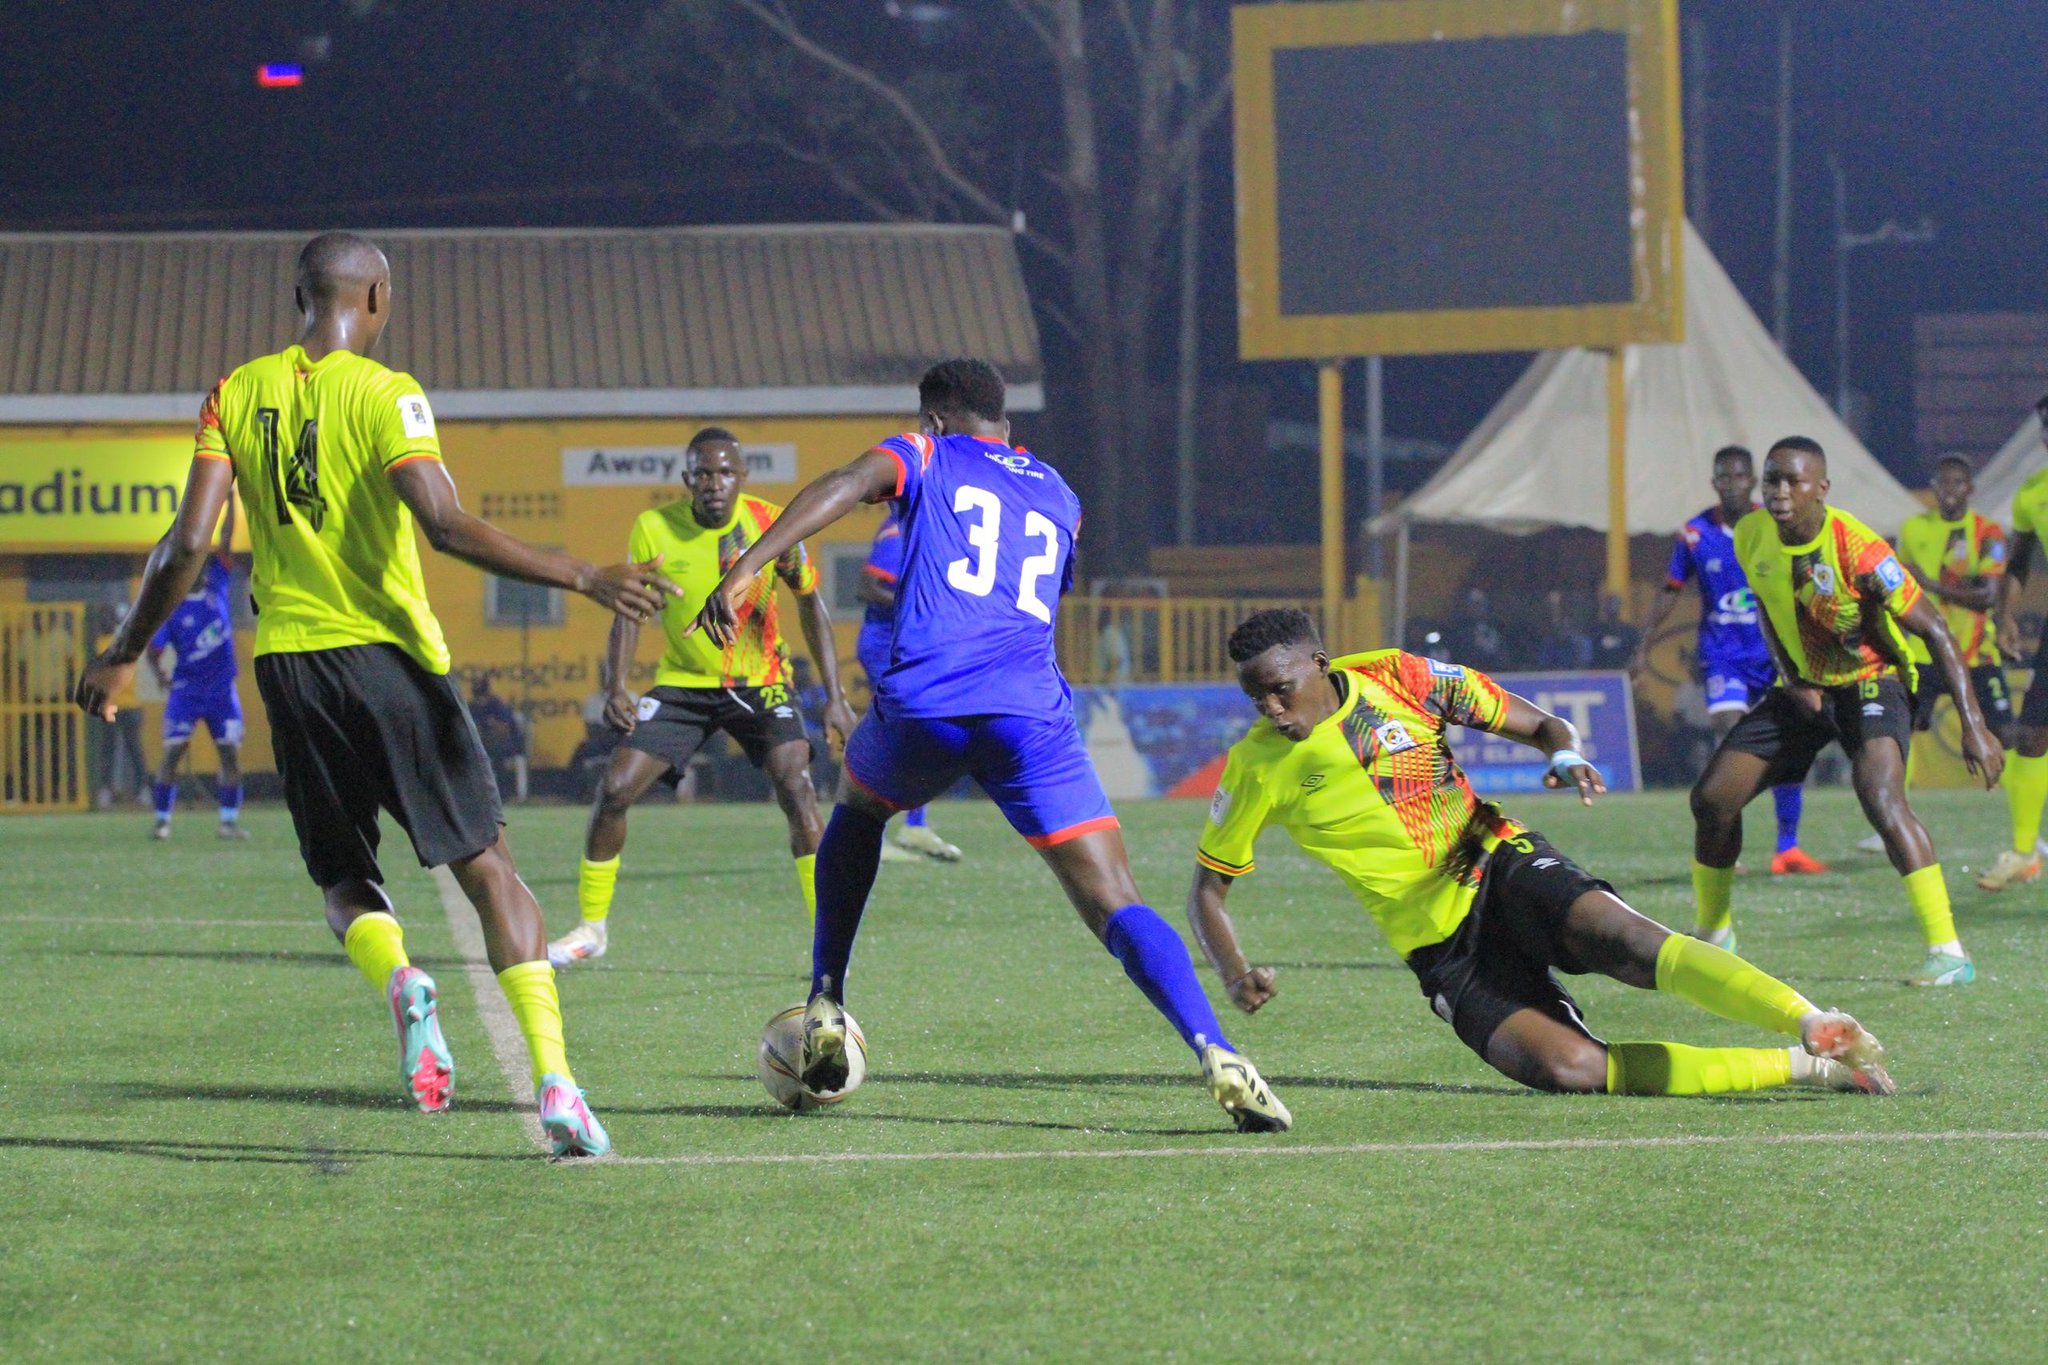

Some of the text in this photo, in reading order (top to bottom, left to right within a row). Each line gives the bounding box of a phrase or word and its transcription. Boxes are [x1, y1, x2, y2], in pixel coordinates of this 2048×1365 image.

[256, 407, 327, 533] 14
[587, 449, 677, 479] Away
[0, 469, 178, 514] adium
[947, 484, 1059, 625] 32
[760, 685, 788, 709] 23
